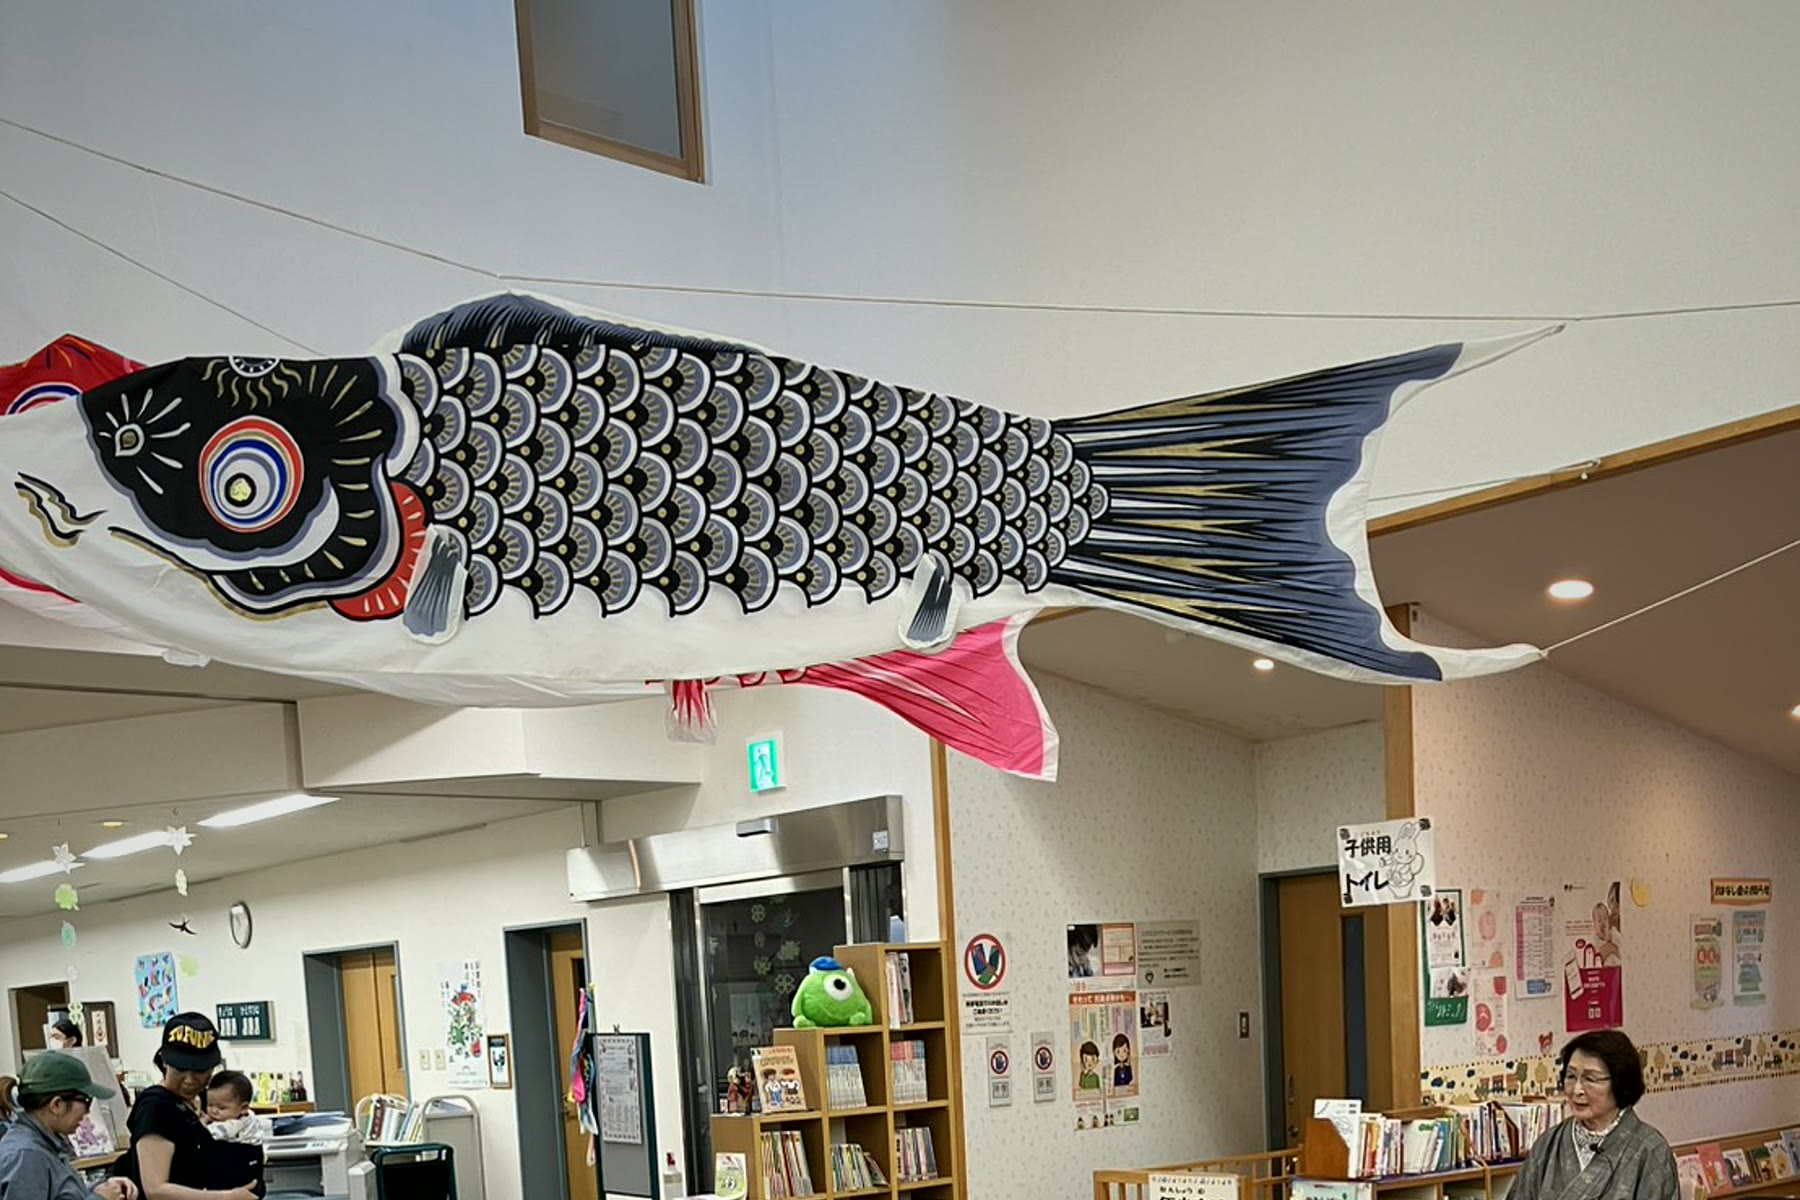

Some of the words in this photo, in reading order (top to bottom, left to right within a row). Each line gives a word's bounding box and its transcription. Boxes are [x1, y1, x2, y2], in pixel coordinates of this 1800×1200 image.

[1344, 835, 1392, 858] 子供用
[1346, 870, 1390, 894] トイレ
